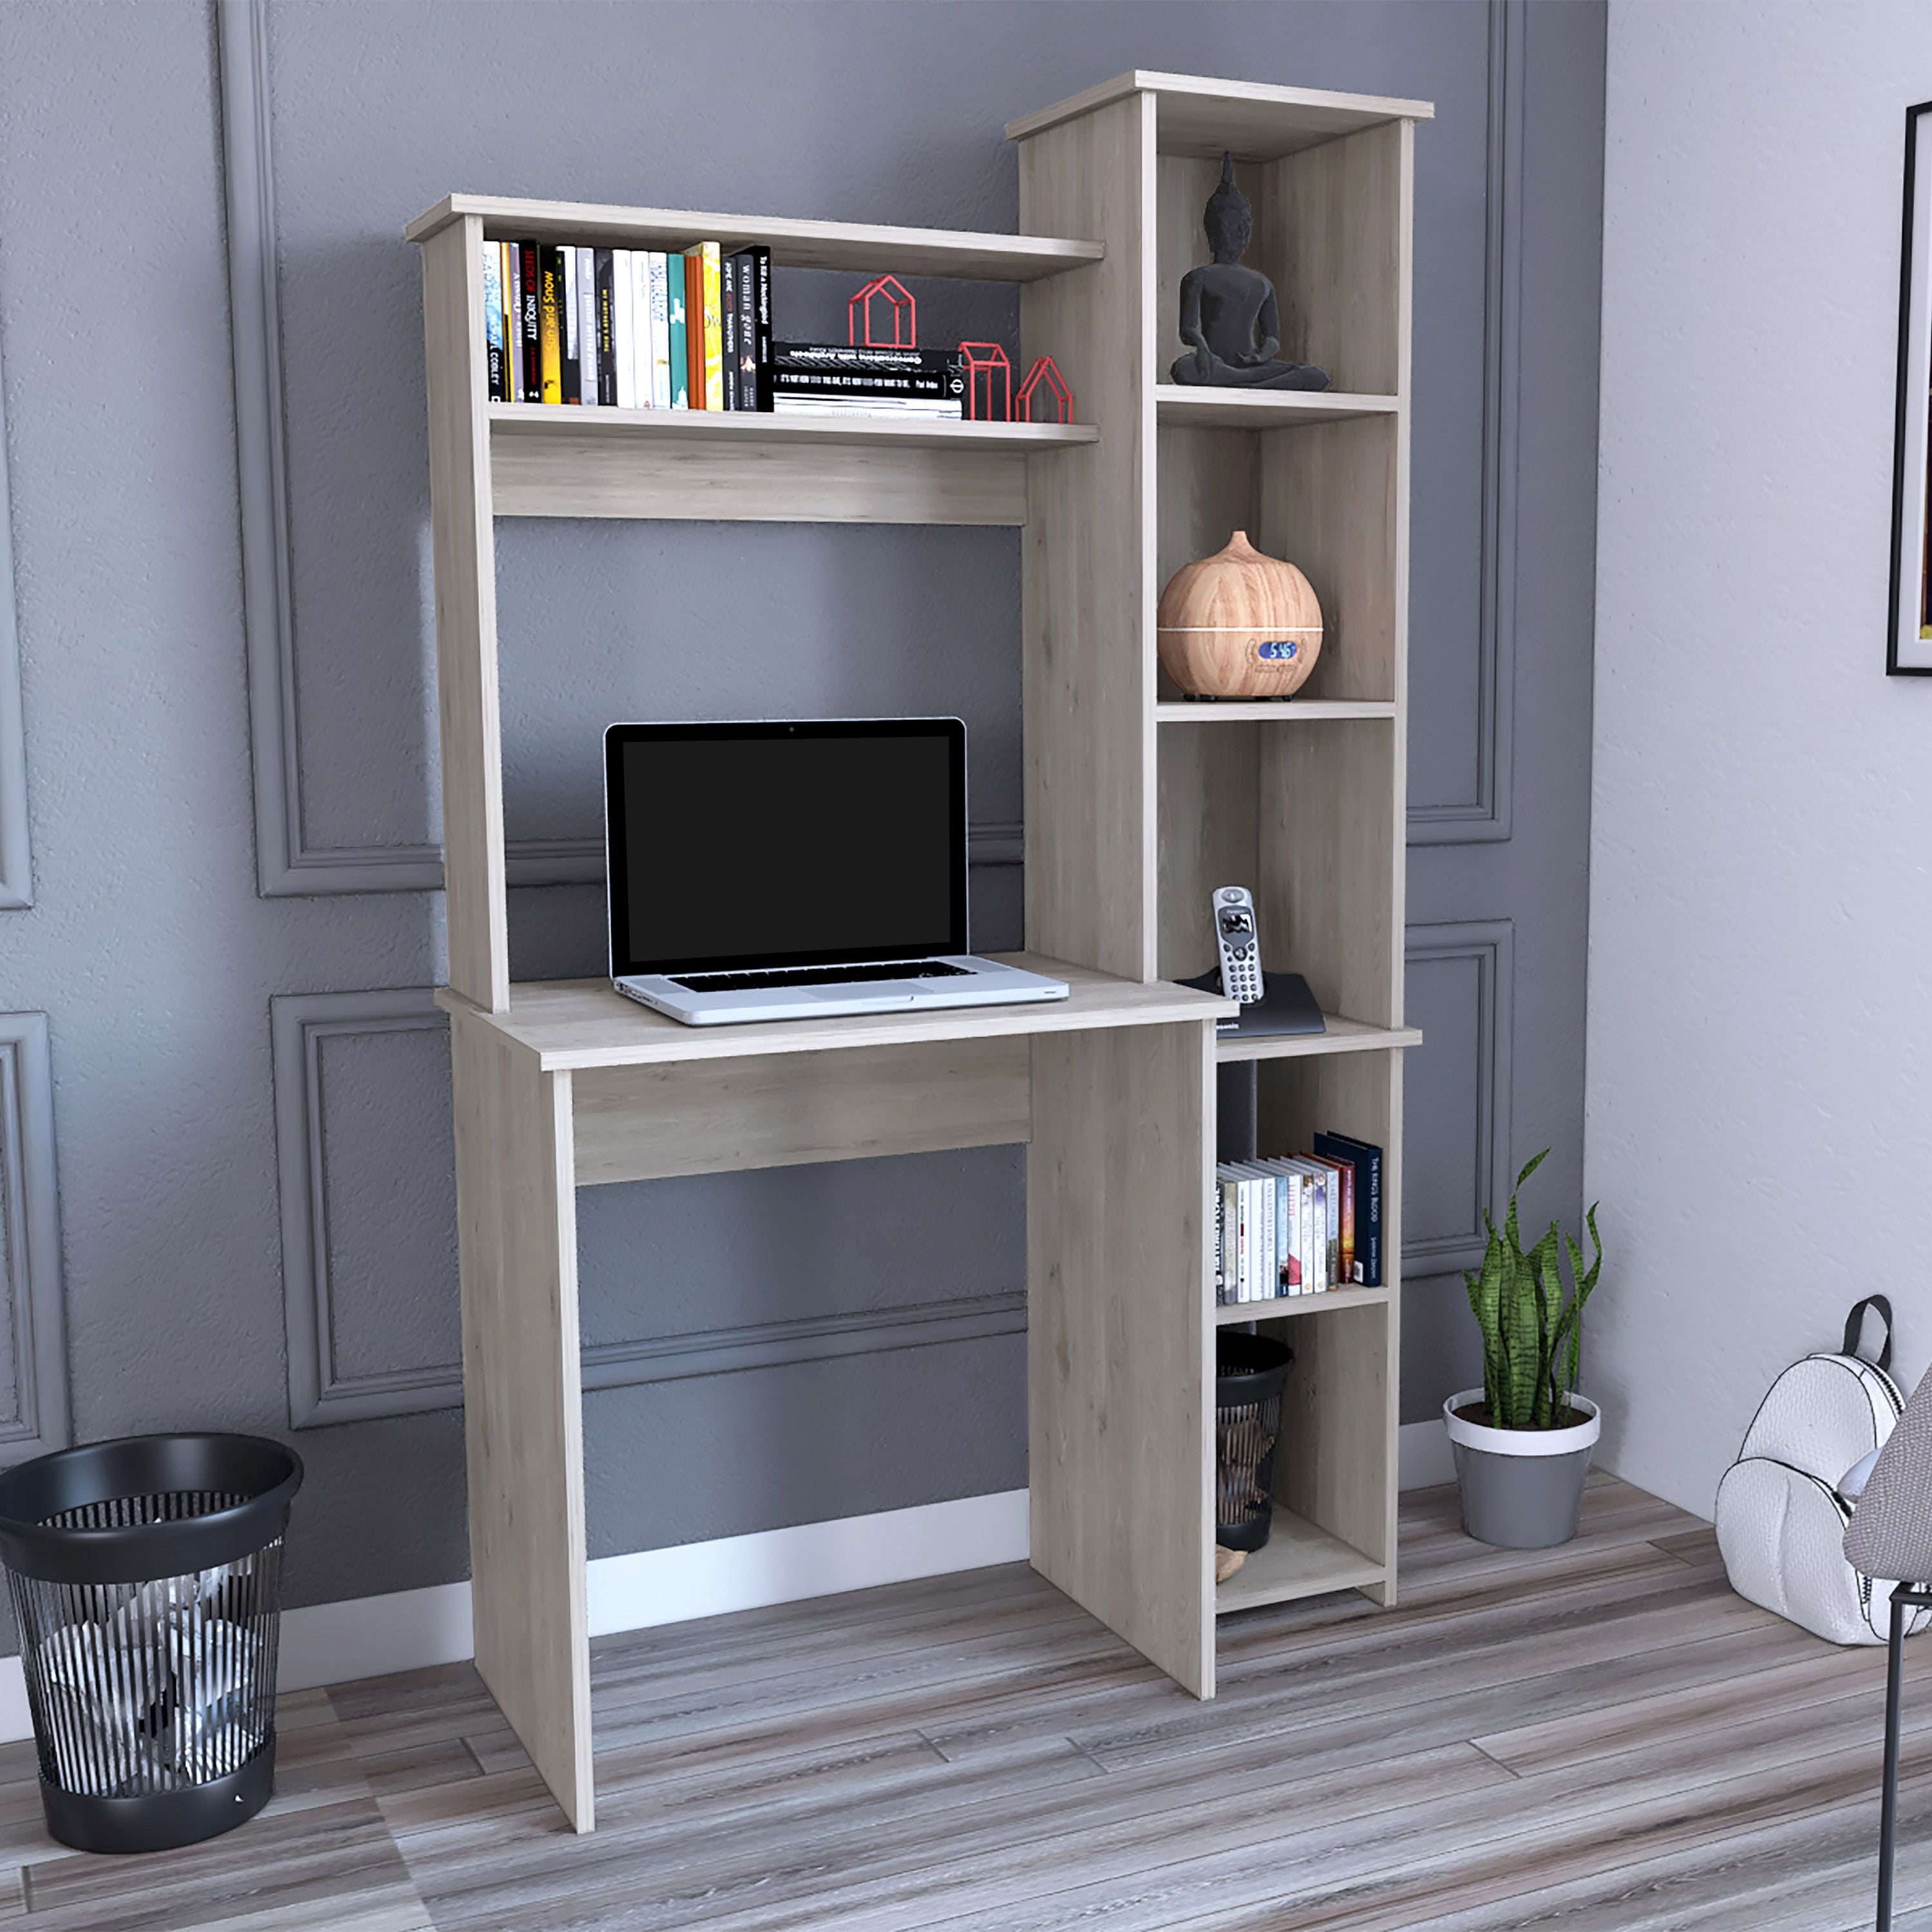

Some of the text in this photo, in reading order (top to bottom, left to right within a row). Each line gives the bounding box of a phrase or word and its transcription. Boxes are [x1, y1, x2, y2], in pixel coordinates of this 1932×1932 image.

[524, 250, 538, 341] SEEDS OF INIQUITY
[543, 270, 556, 303] Snow
[740, 264, 753, 345] woman gone
[544, 306, 556, 329] and
